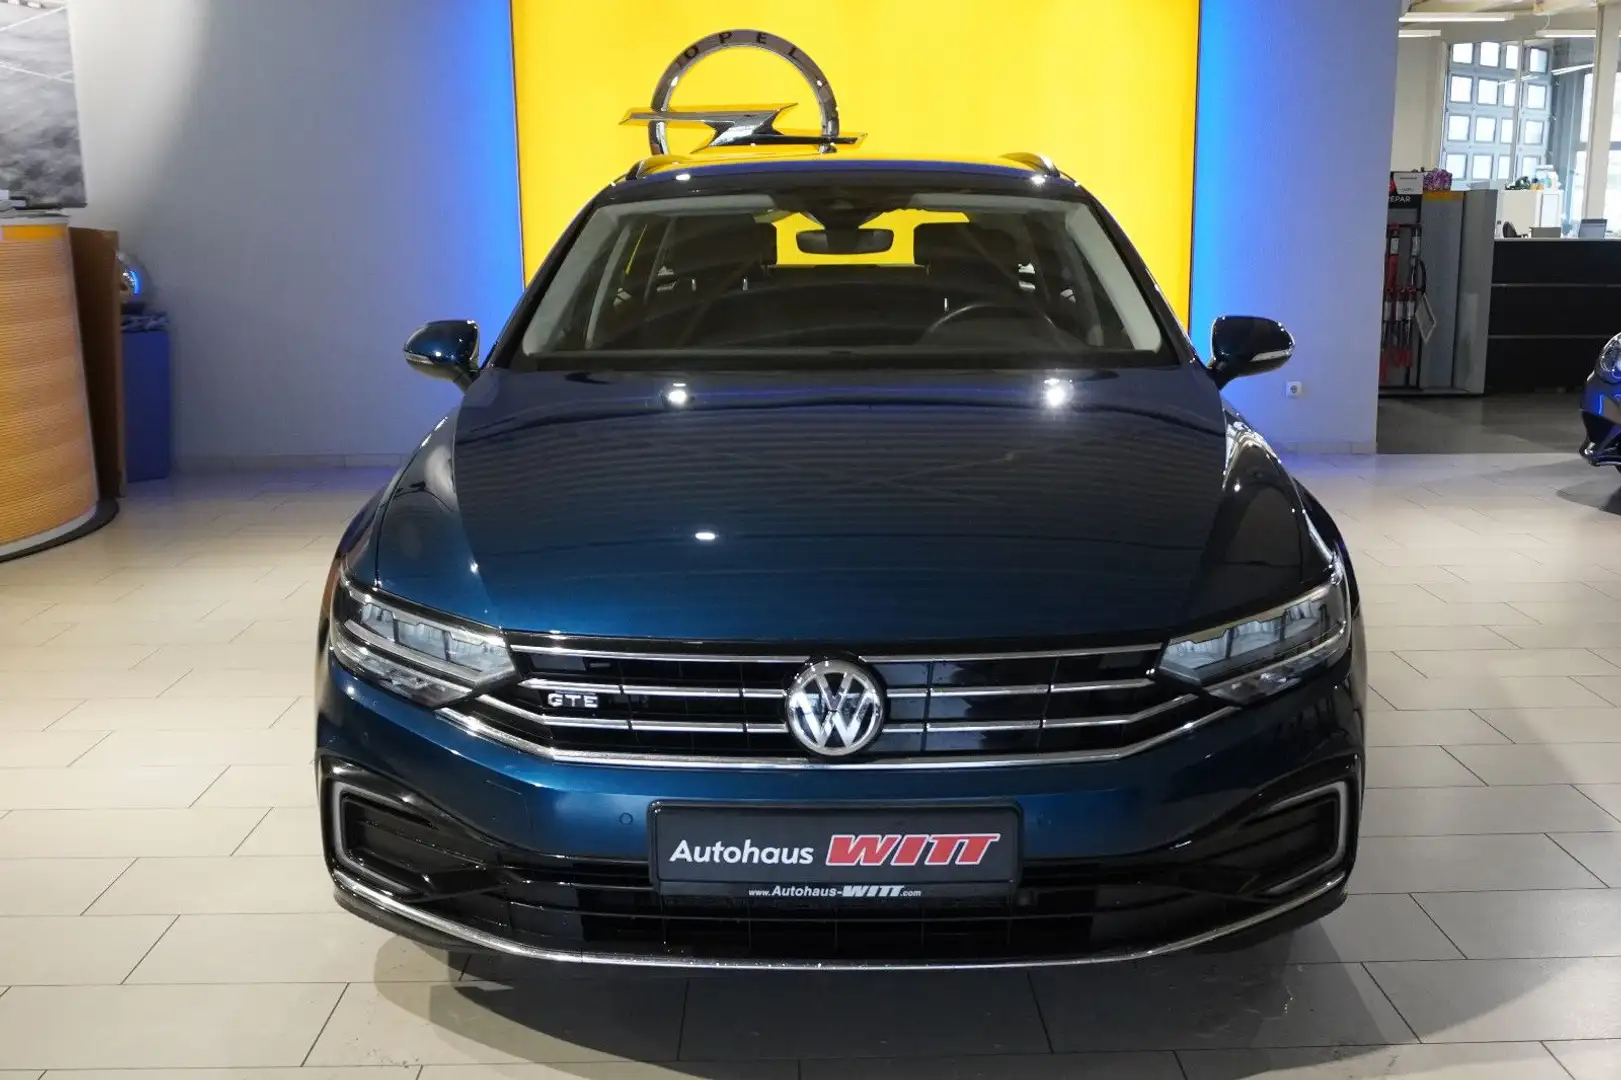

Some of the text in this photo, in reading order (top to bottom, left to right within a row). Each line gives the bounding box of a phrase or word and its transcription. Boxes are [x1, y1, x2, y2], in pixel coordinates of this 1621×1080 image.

[684, 31, 801, 60] OPEL
[547, 692, 598, 708] GTE
[790, 664, 883, 754] VW
[669, 833, 1001, 866] Autohaus WITT
[748, 885, 922, 898] www.Autohaus-WITT.com
